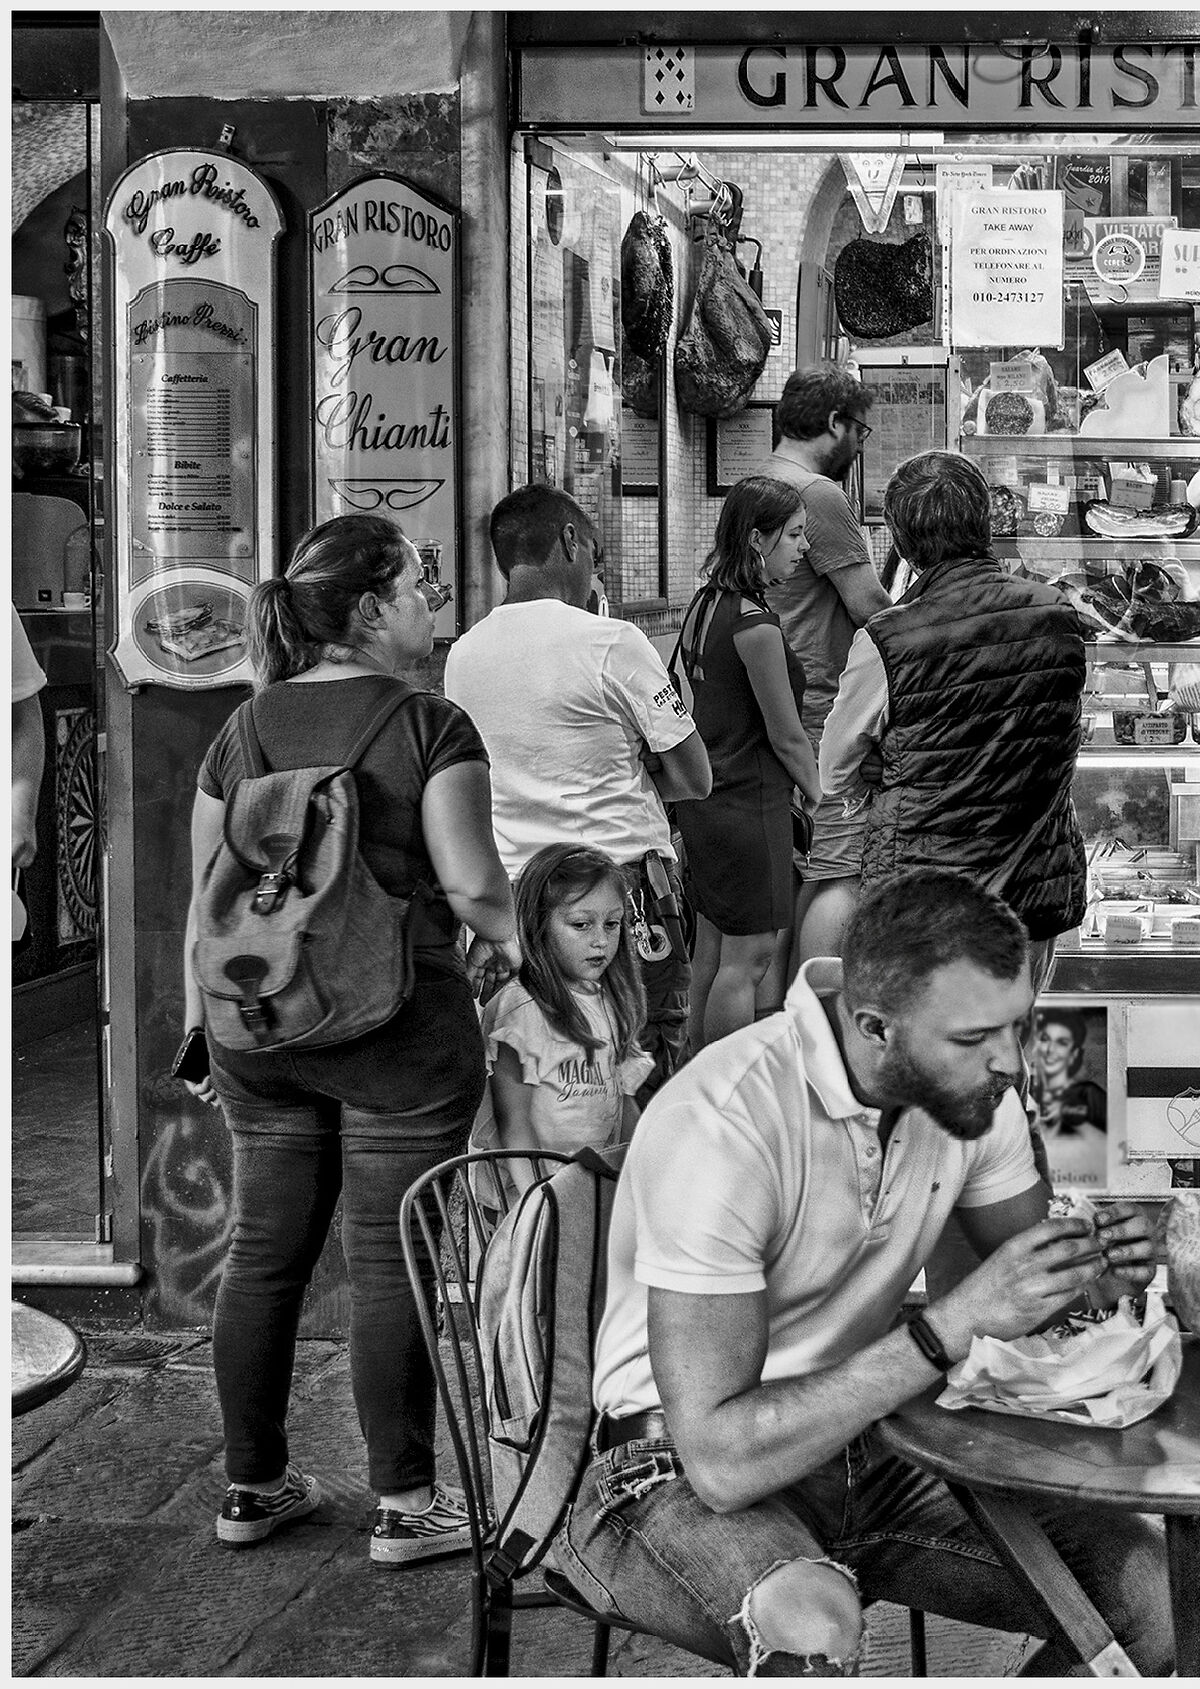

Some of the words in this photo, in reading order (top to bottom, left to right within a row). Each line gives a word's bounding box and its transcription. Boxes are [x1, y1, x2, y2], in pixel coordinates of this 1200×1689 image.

[737, 44, 969, 109] GRAN
[126, 180, 187, 234] Gran
[190, 162, 261, 229] Ristoro
[971, 206, 999, 216] GRAN
[1001, 206, 1047, 216] RISTORO
[313, 202, 360, 254] GRAN
[364, 199, 452, 252] RISTORO
[983, 223, 1006, 232] TAKE
[1008, 223, 1034, 232] AWAY
[1103, 223, 1166, 239] VIETATO
[970, 248, 987, 256] PER
[989, 247, 1047, 256] ORDINAZIONI
[974, 261, 1031, 270] TELEFONARE
[989, 276, 1027, 284] NUMERO
[972, 292, 1044, 303] 010-2473127
[315, 306, 449, 388] Gran
[161, 373, 209, 385] Caffetteria
[316, 390, 452, 451] Chianti
[174, 460, 201, 470] Bibite
[158, 502, 184, 511] Dolce
[191, 502, 222, 511] Salato
